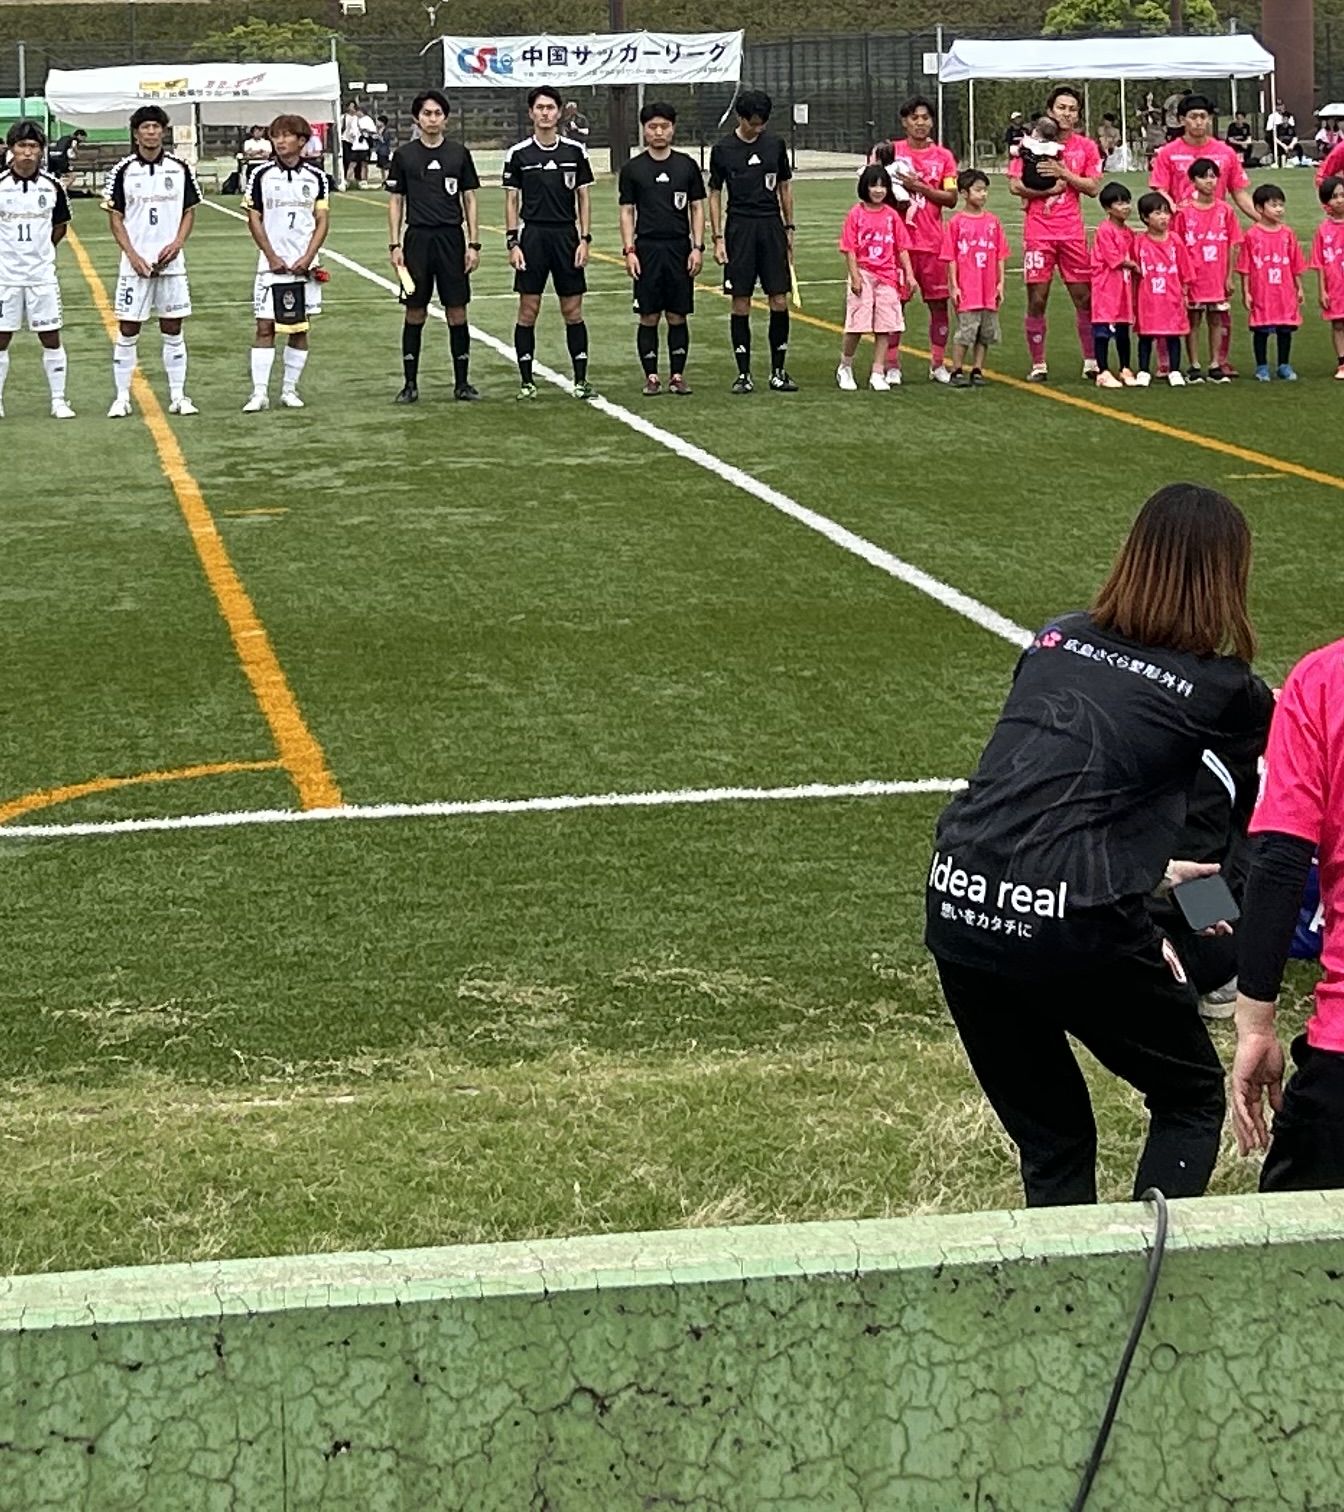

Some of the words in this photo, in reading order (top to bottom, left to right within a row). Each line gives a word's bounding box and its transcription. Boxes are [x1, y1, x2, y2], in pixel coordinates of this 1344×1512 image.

[521, 42, 729, 67] 中国サッカーリーグ
[149, 207, 158, 226] 6
[287, 211, 296, 230] 7
[17, 223, 32, 242] 11
[1024, 251, 1044, 269] 35
[1202, 245, 1218, 262] 12
[1151, 277, 1166, 294] 12
[1268, 268, 1282, 284] 12
[125, 287, 134, 305] 6
[1063, 638, 1195, 698] 広島さくら整形外科
[929, 851, 987, 904] Idea
[997, 881, 1067, 919] real
[940, 901, 1033, 938] 想いをカタチに
